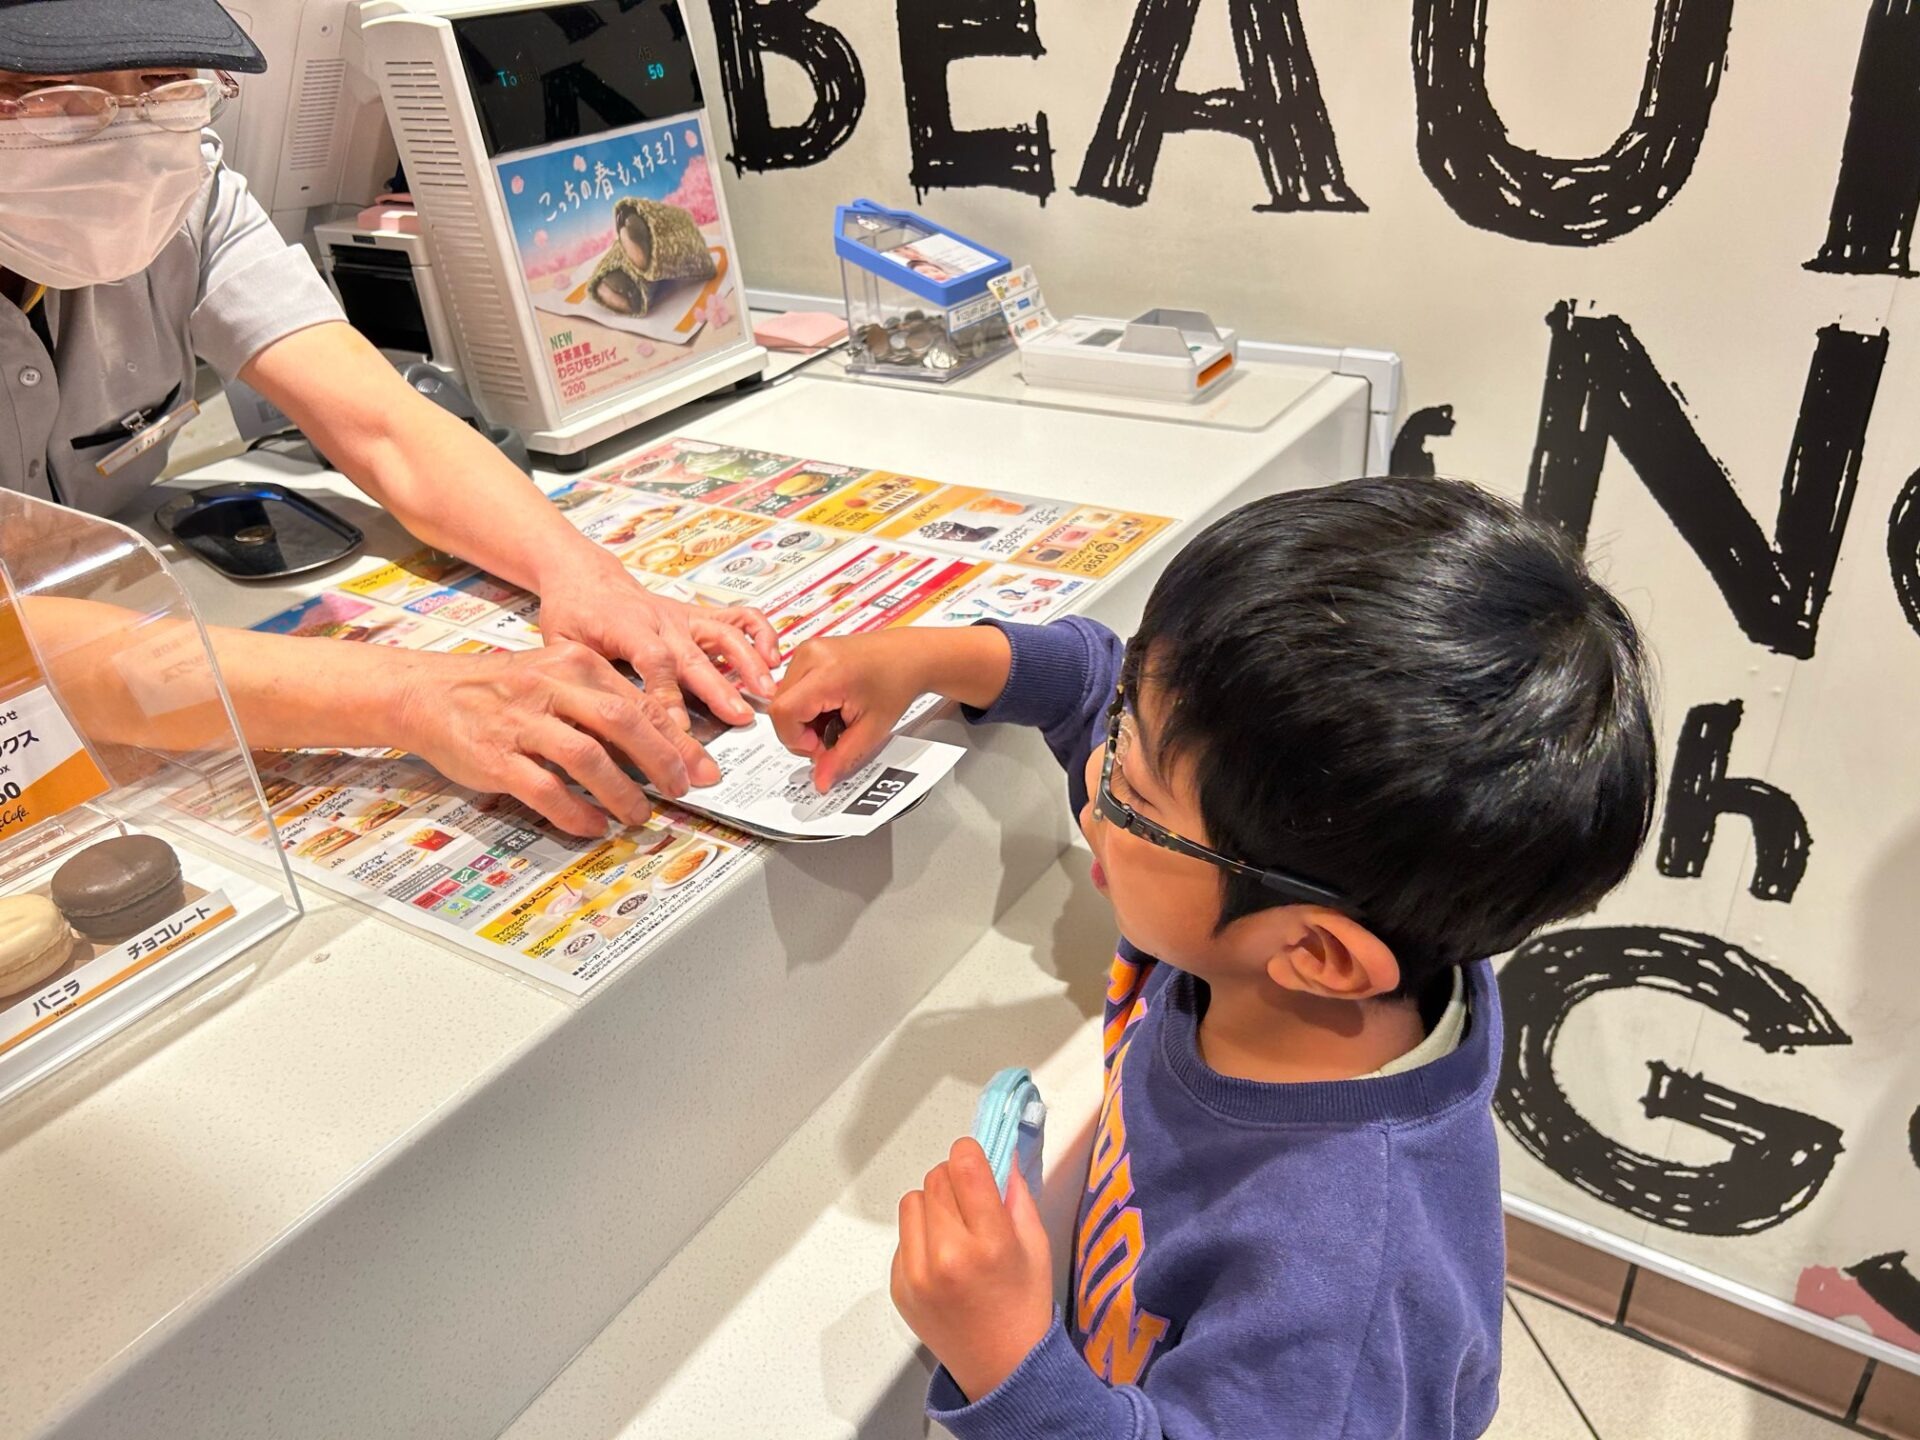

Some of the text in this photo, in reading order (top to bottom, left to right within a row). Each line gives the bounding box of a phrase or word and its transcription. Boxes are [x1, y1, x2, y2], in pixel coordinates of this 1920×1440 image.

[648, 62, 664, 80] 50
[550, 331, 574, 350] NEW
[563, 381, 587, 398] ¥200
[0, 729, 39, 758] クス
[857, 779, 906, 808] 113
[127, 906, 211, 960] チョコレート
[32, 979, 80, 1017] バニラ
